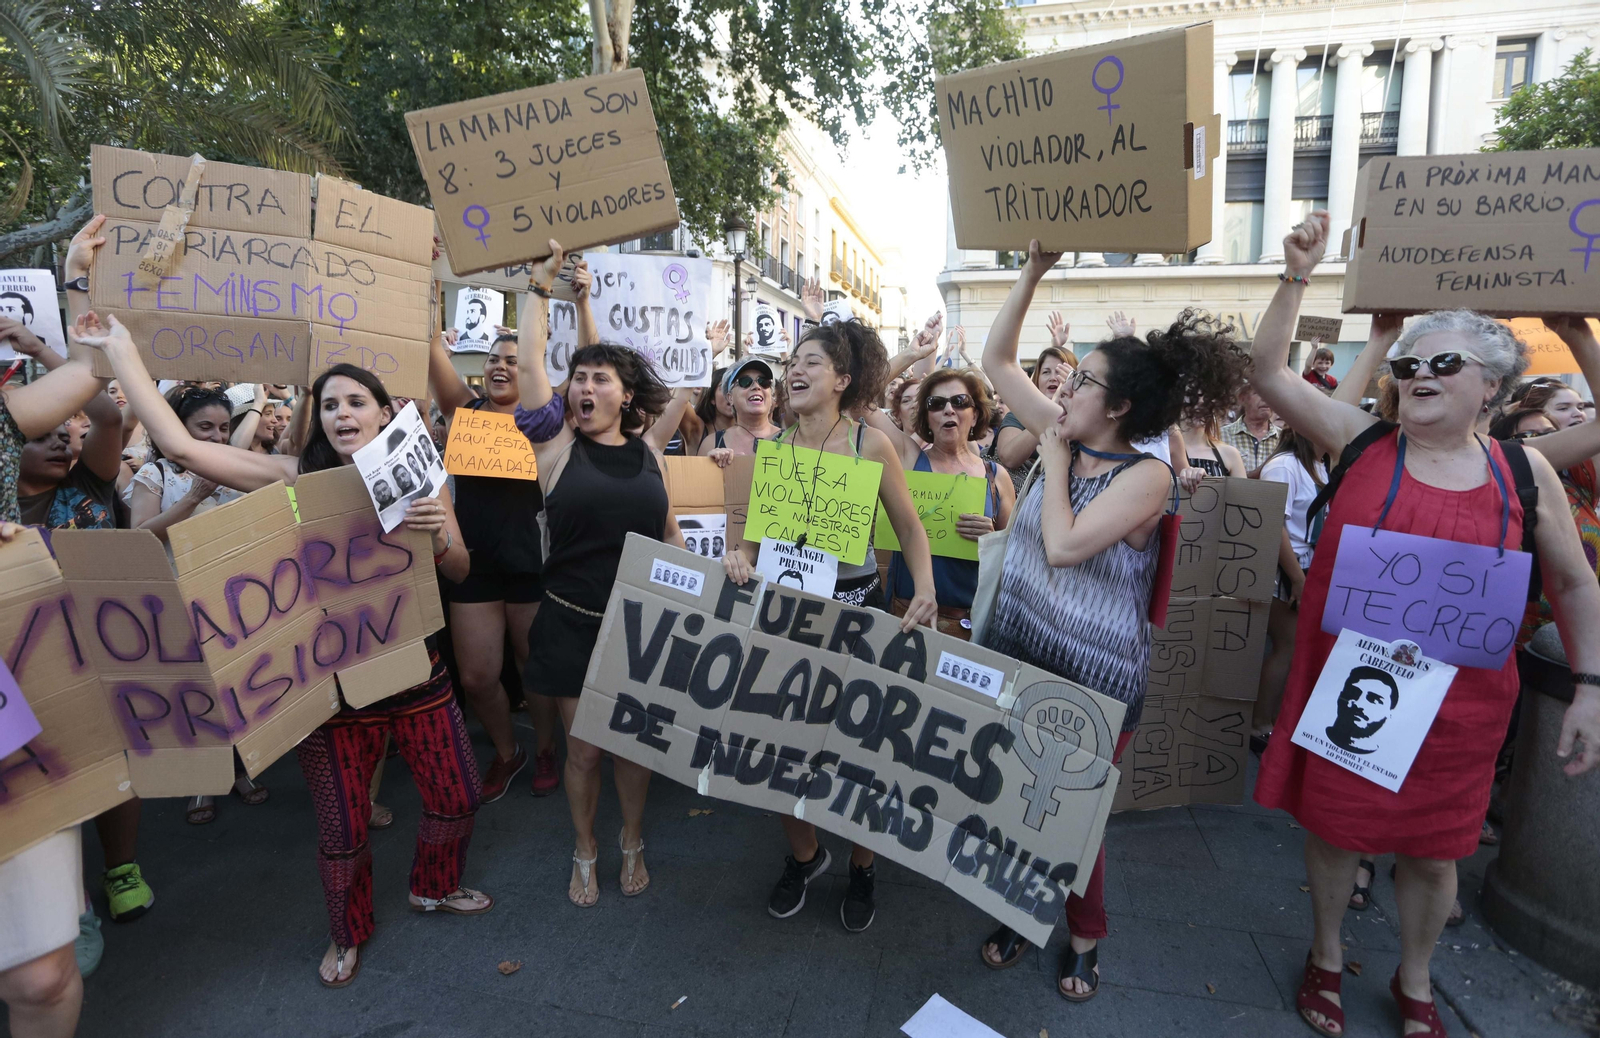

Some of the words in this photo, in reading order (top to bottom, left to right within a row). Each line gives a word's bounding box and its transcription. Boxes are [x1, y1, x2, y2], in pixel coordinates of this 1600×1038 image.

[426, 120, 455, 151] LA
[459, 97, 572, 142] MANADA
[584, 87, 638, 114] SON
[1111, 122, 1147, 155] AL
[439, 162, 473, 194] 8:
[495, 150, 516, 178] 3
[529, 130, 621, 166] JUECES
[1379, 161, 1407, 191] LA
[549, 171, 560, 191] Y
[113, 170, 286, 216] CONTRA
[335, 199, 392, 240] EL
[512, 206, 533, 232] 5
[1394, 198, 1424, 217] EN
[1437, 197, 1462, 216] SU
[1378, 243, 1535, 264] AUTODEFENSA
[608, 303, 694, 344] GUSTAS
[662, 346, 709, 380] CALLAS
[452, 433, 490, 445] AQUÍ
[459, 416, 521, 434] HERMA
[447, 453, 522, 473] MANADA
[485, 447, 500, 455] TU
[762, 456, 848, 492] FUERA
[754, 481, 871, 526] VIOLADORES
[760, 504, 778, 516] DE
[792, 512, 860, 539] NUESTRAS
[1178, 520, 1205, 566] DE
[779, 556, 814, 574] PRENDA
[1213, 501, 1263, 652] BASTA
[1369, 547, 1421, 586] YO
[1437, 561, 1505, 598] SÍ
[714, 577, 927, 683] FUERA
[1335, 584, 1397, 626] TE
[1402, 599, 1516, 655] CREO
[117, 595, 402, 745] PRISIÓN
[1359, 653, 1415, 680] CABEZUELO
[1175, 708, 1245, 787] YA
[1301, 731, 1314, 741] SOY
[1315, 736, 1325, 746] UN
[1325, 741, 1357, 761] VIOLADOR
[1363, 758, 1371, 768] EL
[1371, 763, 1398, 780] ESTADO
[1325, 750, 1335, 759] LO
[1335, 754, 1364, 773] PERMITE
[608, 692, 677, 754] DE
[690, 725, 939, 852] NUESTRAS
[947, 814, 1078, 926] CALLES
